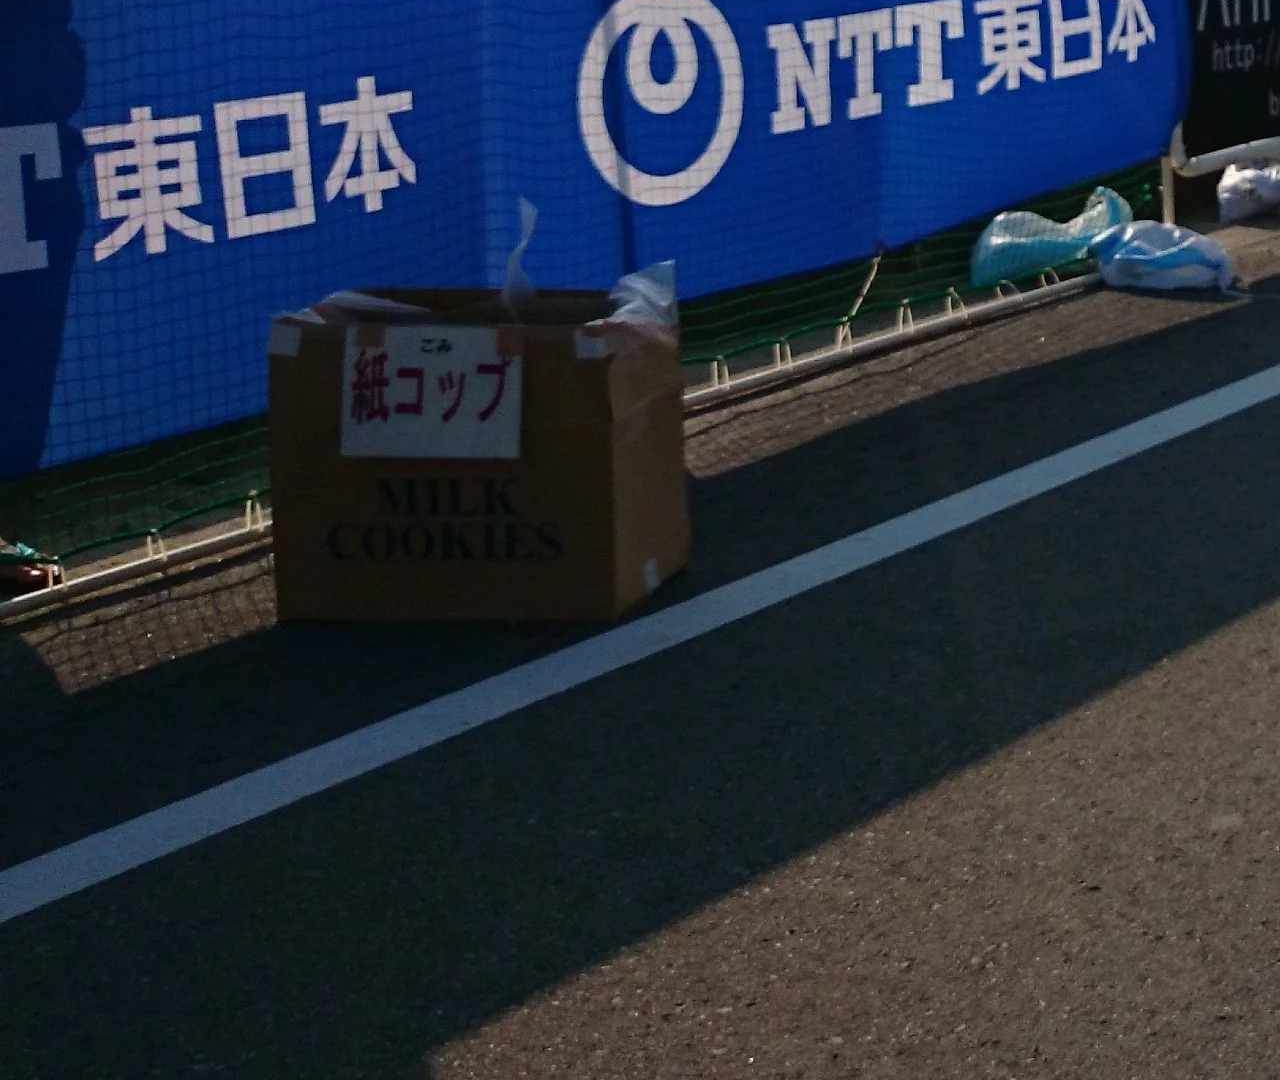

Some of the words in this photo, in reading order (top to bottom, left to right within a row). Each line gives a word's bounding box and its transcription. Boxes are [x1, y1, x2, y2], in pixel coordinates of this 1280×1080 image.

[351, 349, 515, 424] 紙コップ
[376, 477, 518, 516] MILK
[325, 521, 566, 561] COOKIES
